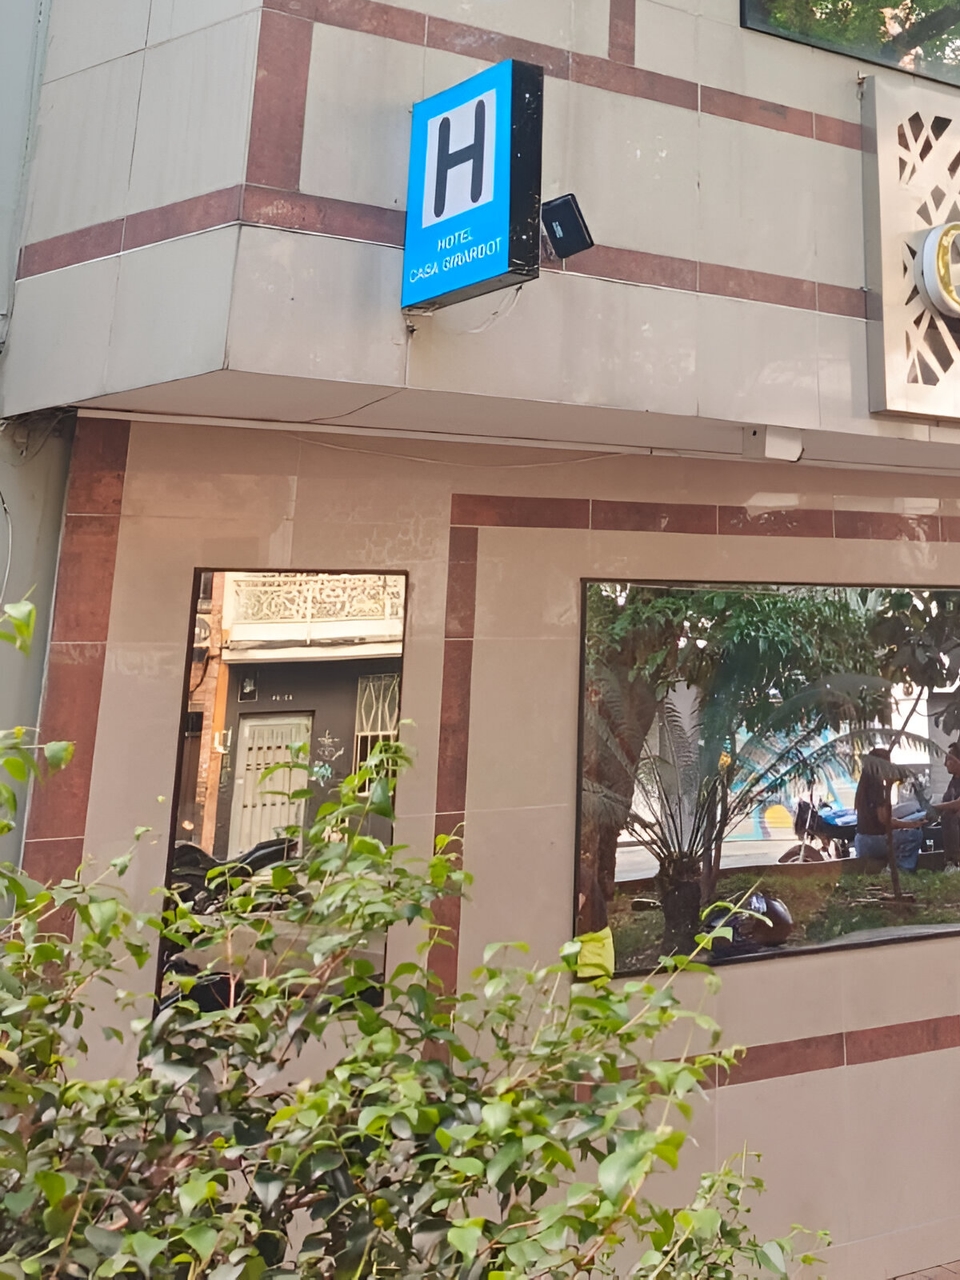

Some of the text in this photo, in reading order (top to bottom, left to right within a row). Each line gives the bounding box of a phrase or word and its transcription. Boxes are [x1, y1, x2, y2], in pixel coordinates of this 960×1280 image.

[434, 98, 486, 218] H
[409, 236, 502, 283] CASA GIRARDOT
[437, 227, 473, 252] HOTEL
